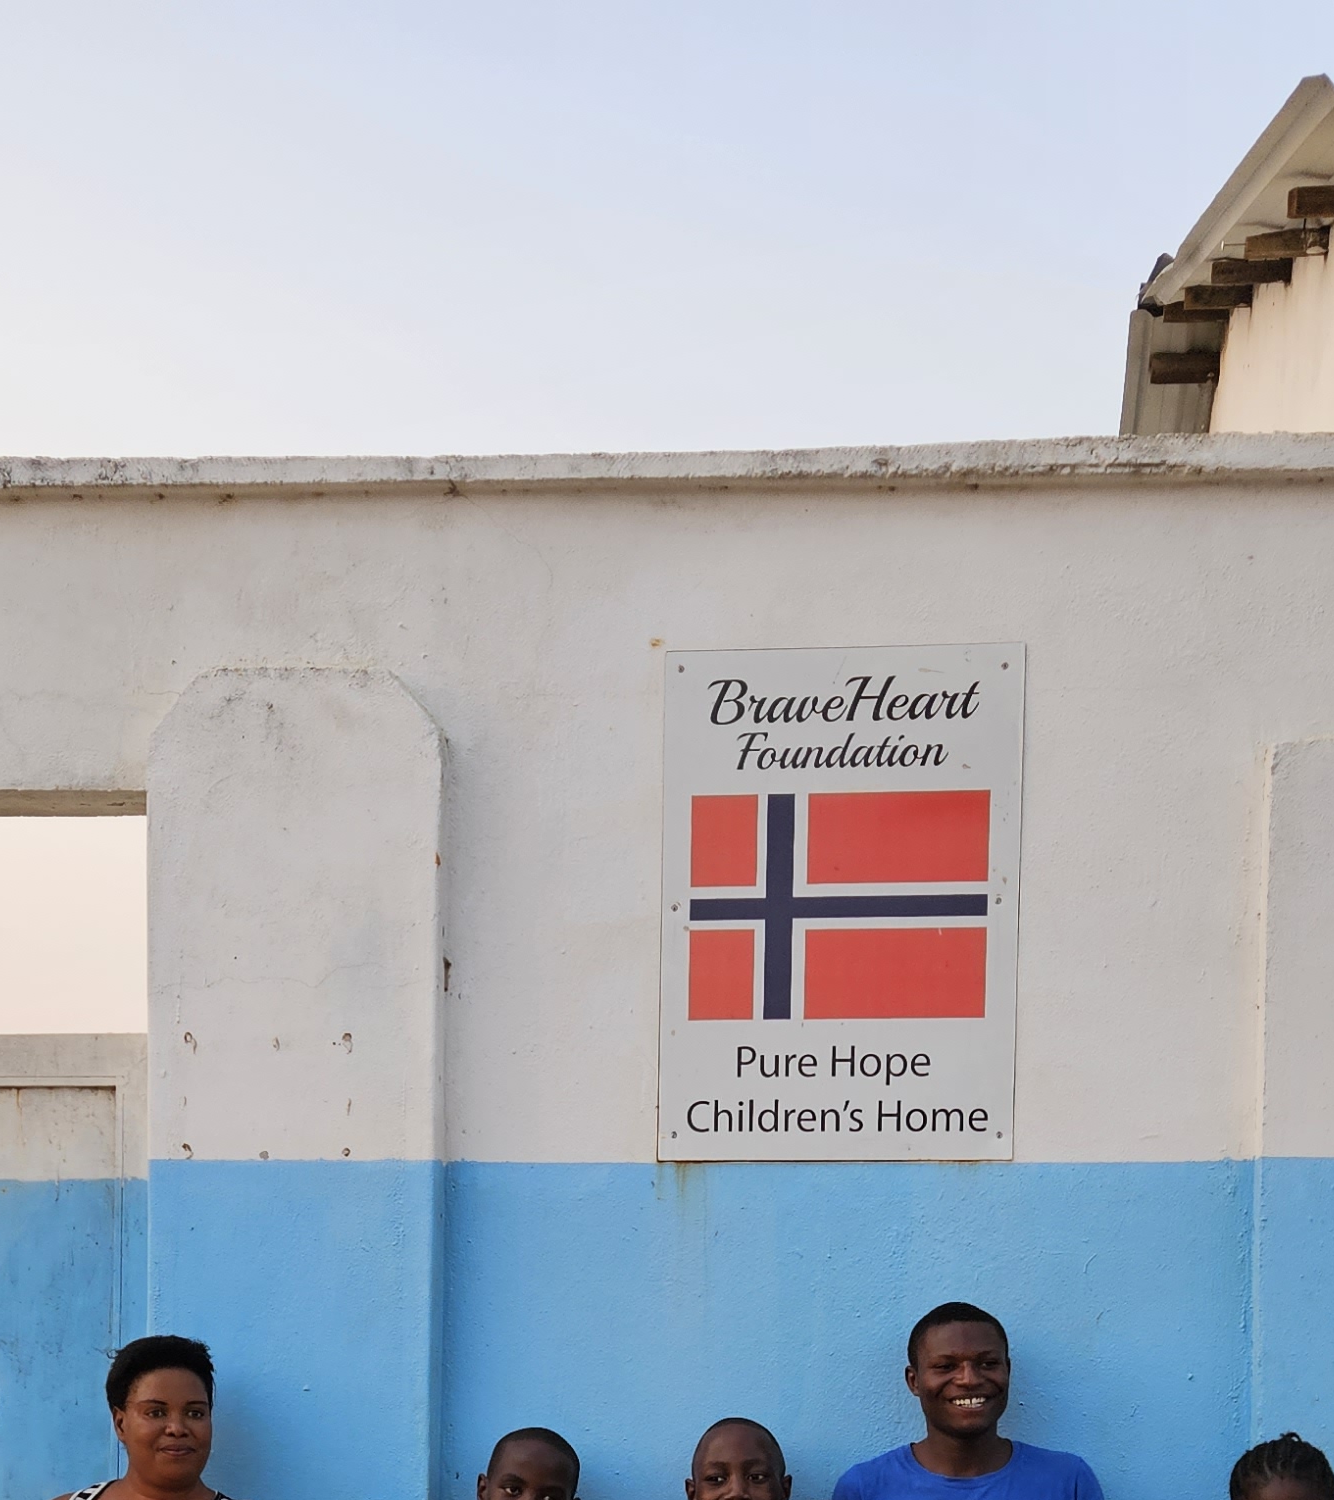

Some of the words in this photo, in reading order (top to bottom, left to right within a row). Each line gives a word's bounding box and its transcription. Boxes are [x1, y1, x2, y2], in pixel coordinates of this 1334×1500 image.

[707, 675, 980, 726] BraveHeart
[735, 731, 949, 771] Foundation
[736, 1045, 818, 1078] Pure
[831, 1045, 931, 1086] Hope
[686, 1098, 865, 1133] Children’s
[877, 1099, 989, 1133] Home
